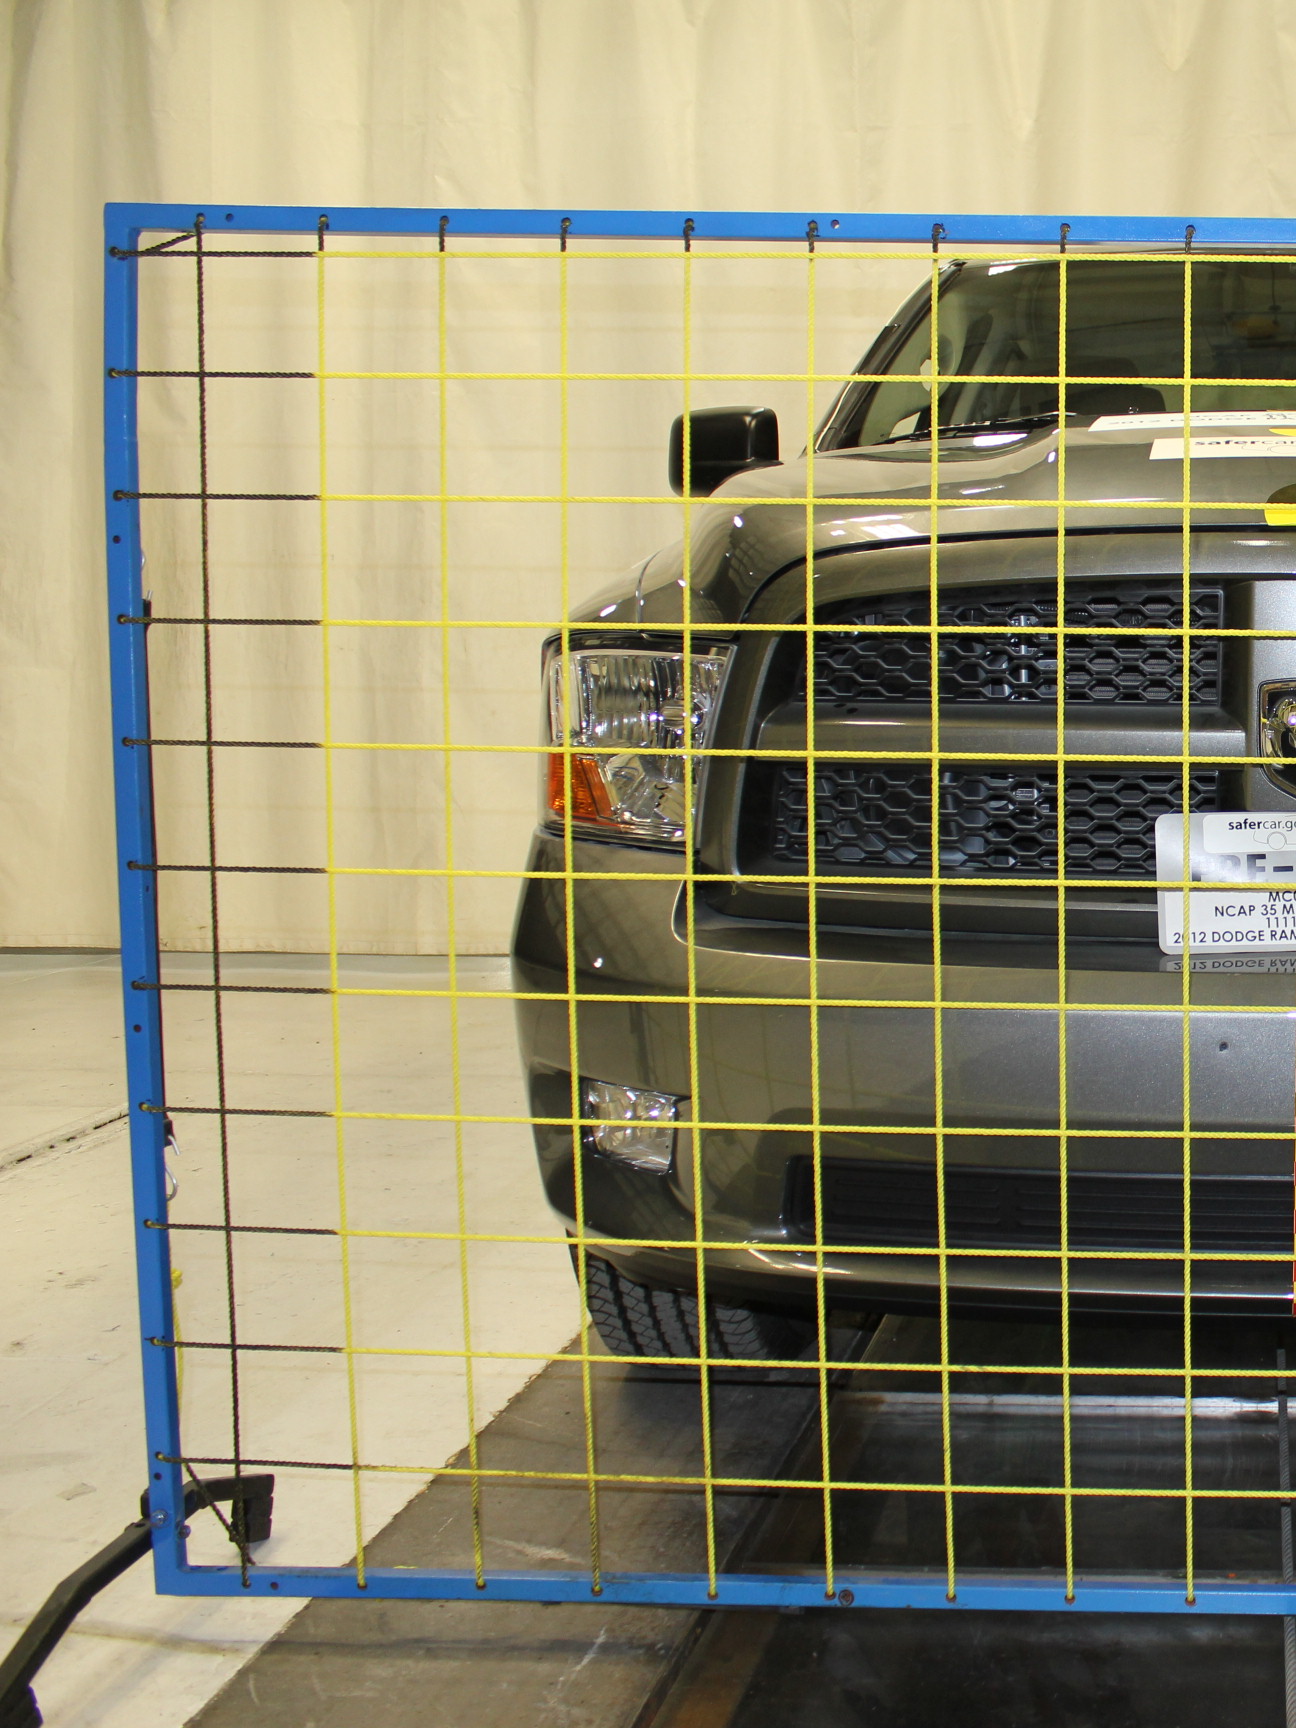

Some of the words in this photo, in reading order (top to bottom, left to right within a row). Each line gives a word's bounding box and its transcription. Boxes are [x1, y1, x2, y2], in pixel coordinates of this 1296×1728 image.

[1214, 905, 1256, 917] NCAP
[1261, 903, 1277, 916] 35
[1212, 930, 1265, 943] DODGE
